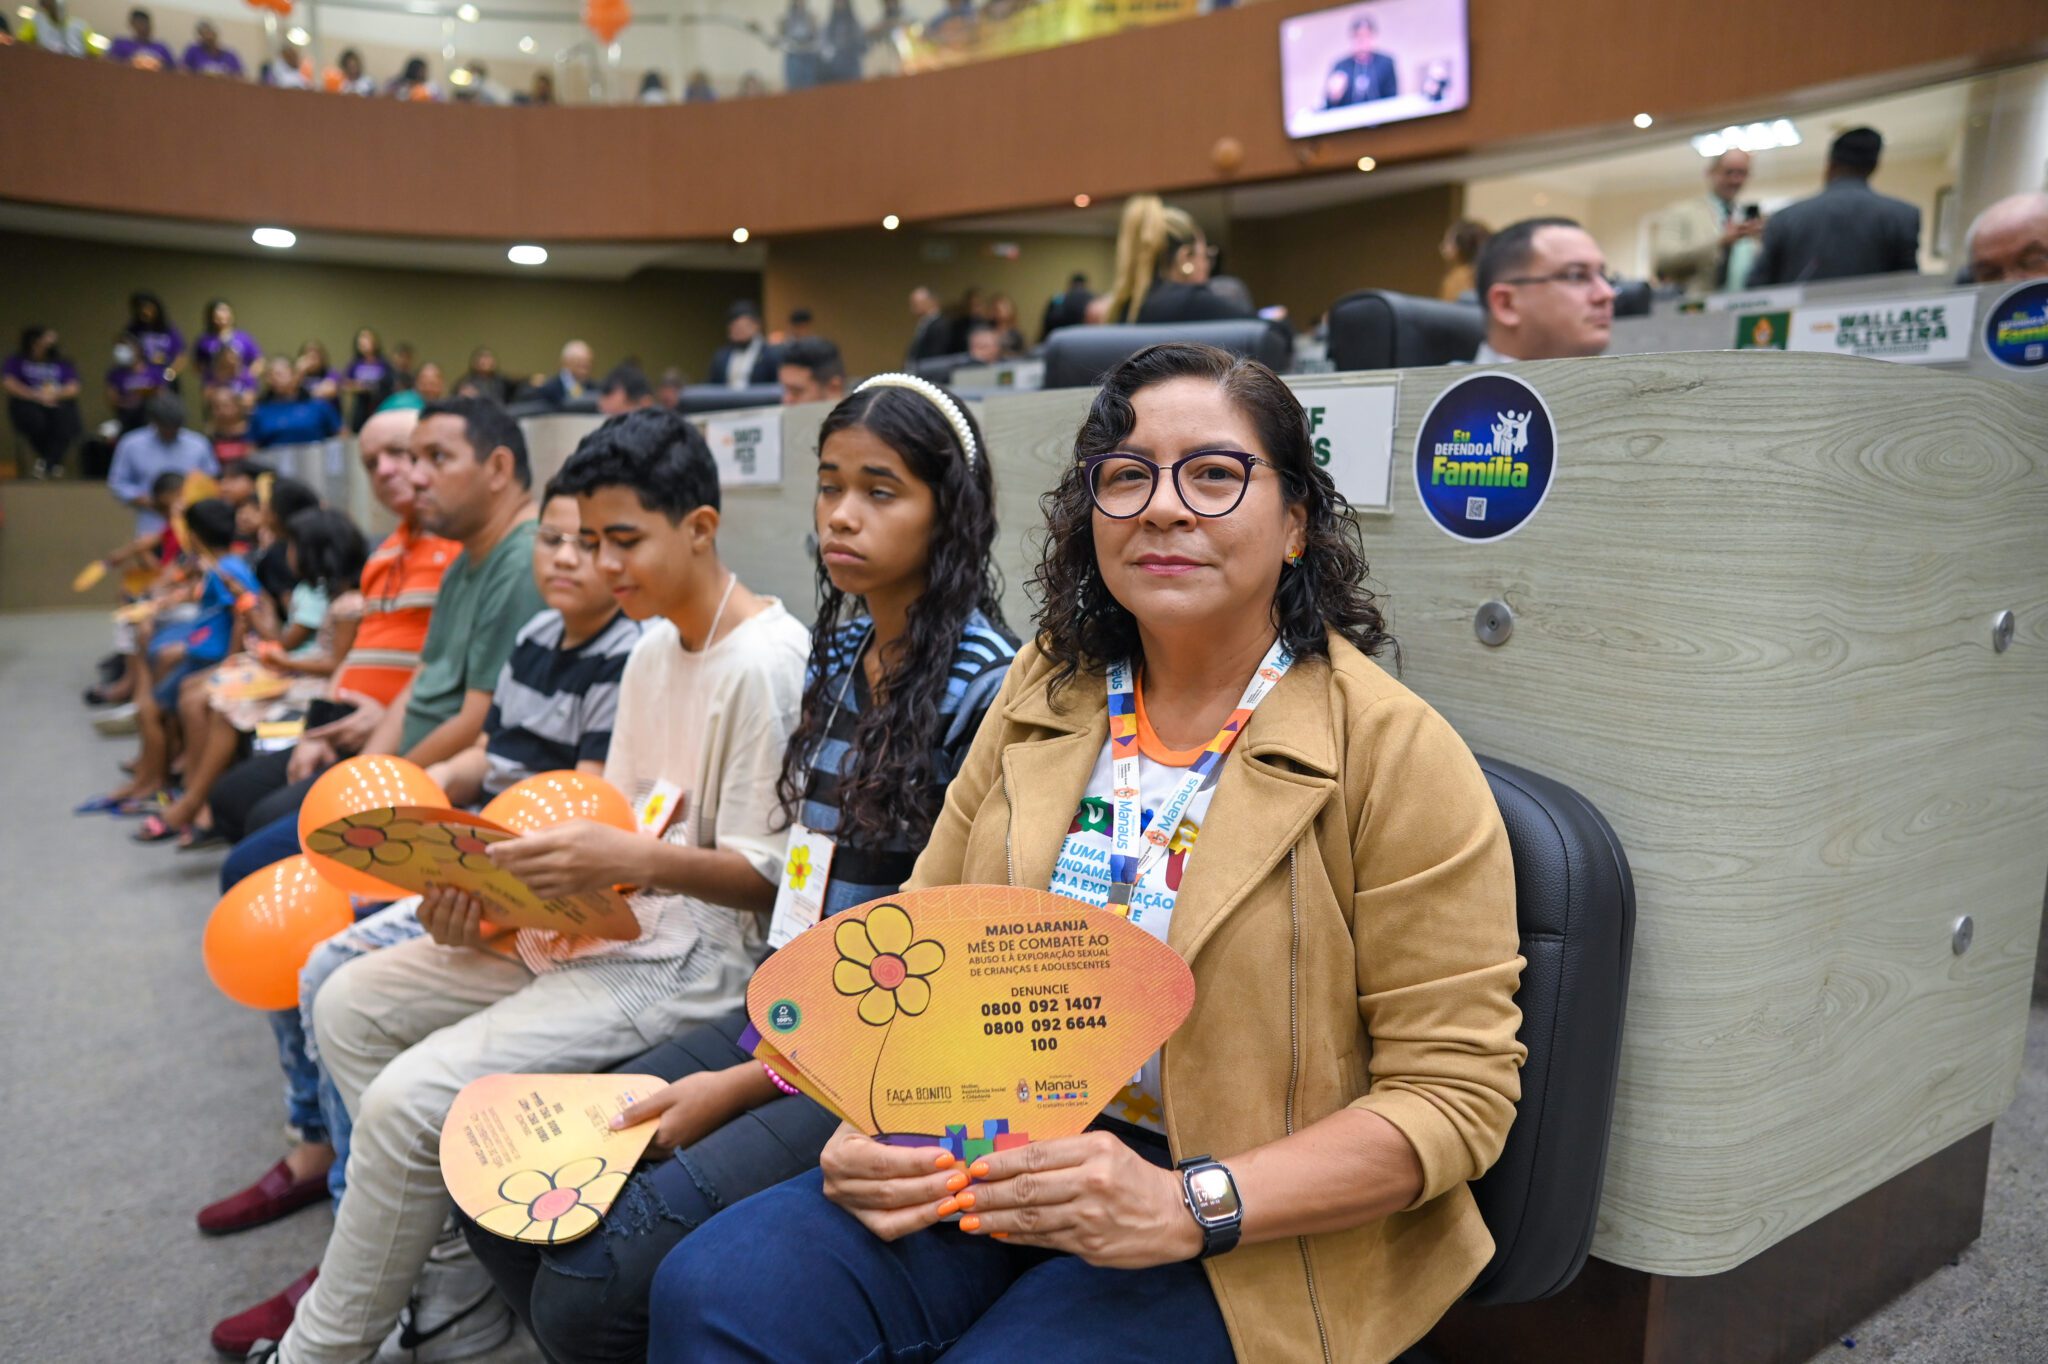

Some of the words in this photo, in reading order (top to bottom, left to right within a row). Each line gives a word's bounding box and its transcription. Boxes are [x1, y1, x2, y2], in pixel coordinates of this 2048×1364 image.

[1839, 304, 1946, 328] WALLACE
[1835, 325, 1948, 348] OLIVEIRA
[1453, 429, 1471, 443] Eu
[1434, 442, 1484, 456] DEFENDO
[1484, 442, 1493, 456] A
[1431, 455, 1529, 488] Família
[1157, 778, 1199, 831] Manaus
[1116, 800, 1133, 850] Manaus
[1069, 842, 1106, 864] UMA
[985, 923, 1024, 936] MAIO
[1027, 920, 1088, 934] LARANJA
[967, 940, 995, 954] MÊS
[999, 940, 1015, 952] DE
[1018, 935, 1084, 950] COMBATE
[1088, 934, 1109, 947] AO
[969, 954, 999, 965] ABUSO
[1001, 954, 1006, 962] E
[1017, 949, 1075, 961] EXPLORAÇÃO
[1077, 948, 1109, 958] SEXUAL
[970, 968, 982, 977] DE
[984, 964, 1031, 976] CRIANÇAS
[1034, 963, 1038, 972] E
[1041, 960, 1110, 972] ADOLESCENTES
[1011, 983, 1070, 997] DENUNCIE
[981, 1001, 1021, 1016] 0800
[1029, 999, 1059, 1013] 092
[1065, 996, 1102, 1011] 1407
[983, 1020, 1024, 1035] 0800
[1031, 1018, 1061, 1032] 092
[1066, 1015, 1107, 1030] 6644
[1031, 1037, 1058, 1051] 100
[886, 1088, 913, 1102] FAÇA
[916, 1086, 952, 1100] BONITO
[1035, 1079, 1088, 1092] Manaus
